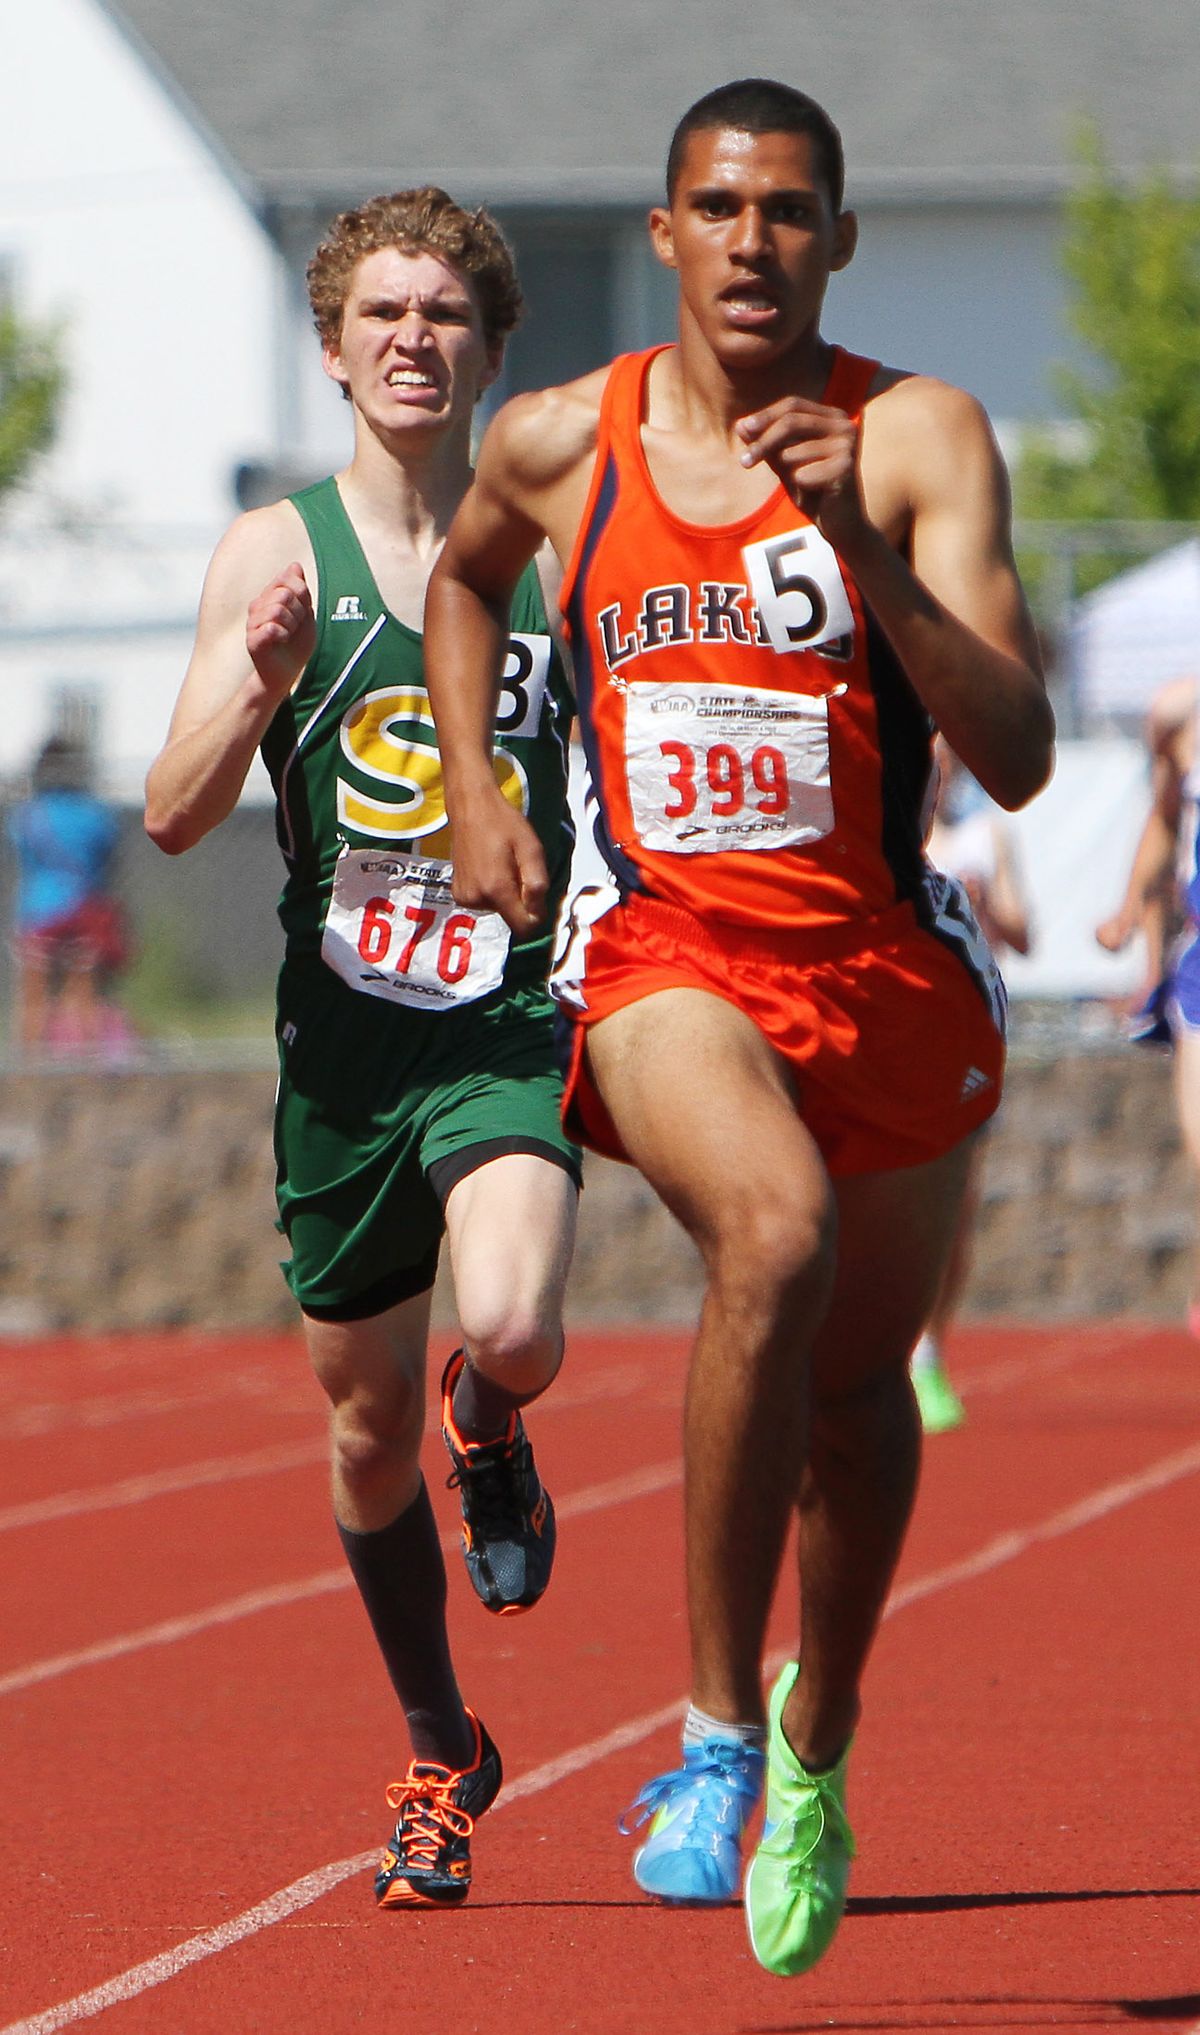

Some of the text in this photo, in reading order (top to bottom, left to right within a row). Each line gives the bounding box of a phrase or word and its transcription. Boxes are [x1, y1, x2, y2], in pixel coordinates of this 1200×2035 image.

[764, 536, 828, 642] 5
[700, 695, 736, 706] STATE
[697, 707, 801, 720] CHAMPIONSHIPS
[659, 739, 790, 819] 399
[716, 821, 788, 836] BROOKS
[358, 896, 476, 984] 676
[392, 979, 457, 1001] BROOKS
